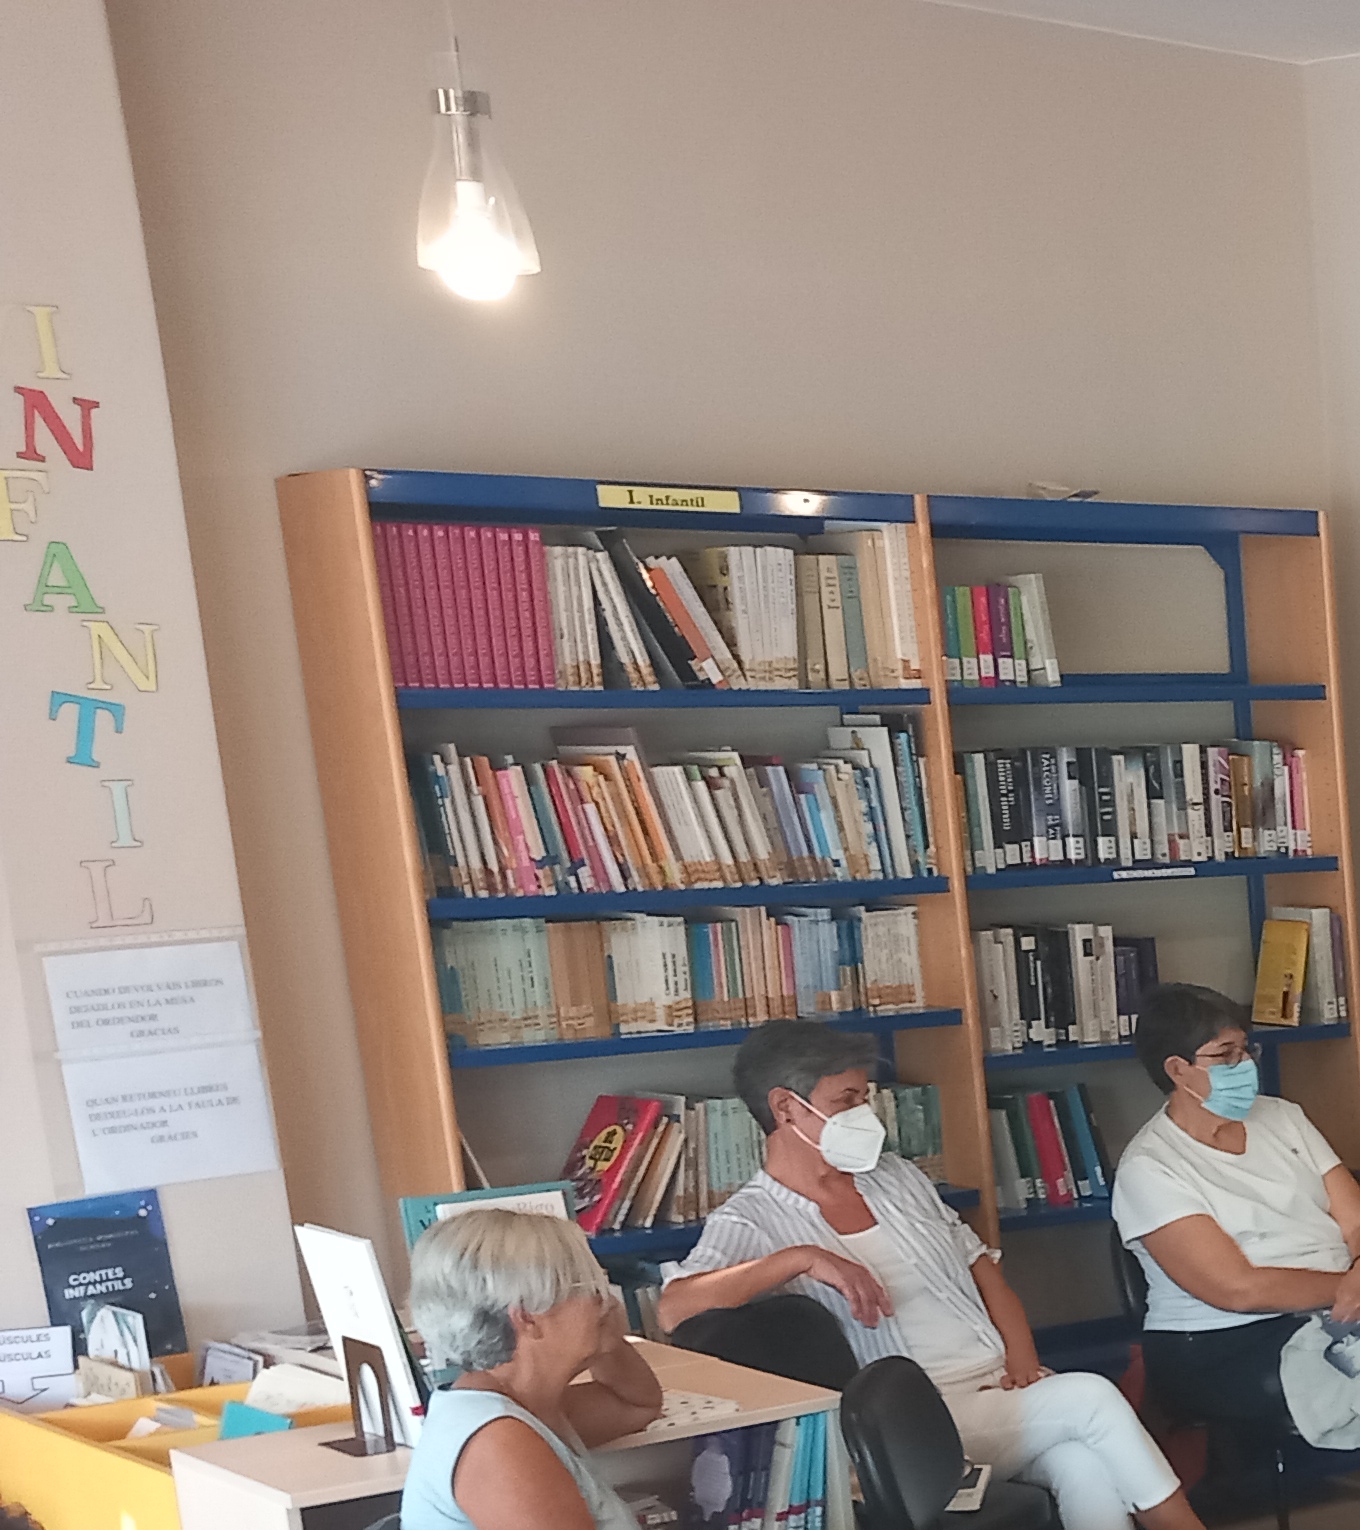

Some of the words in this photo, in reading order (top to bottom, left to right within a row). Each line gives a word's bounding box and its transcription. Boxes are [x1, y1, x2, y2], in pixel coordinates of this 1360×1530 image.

[648, 494, 705, 508] Infantil
[130, 1026, 180, 1039] GRACIAS
[68, 1266, 124, 1286] CONTES
[64, 1278, 134, 1299] INFANTILS
